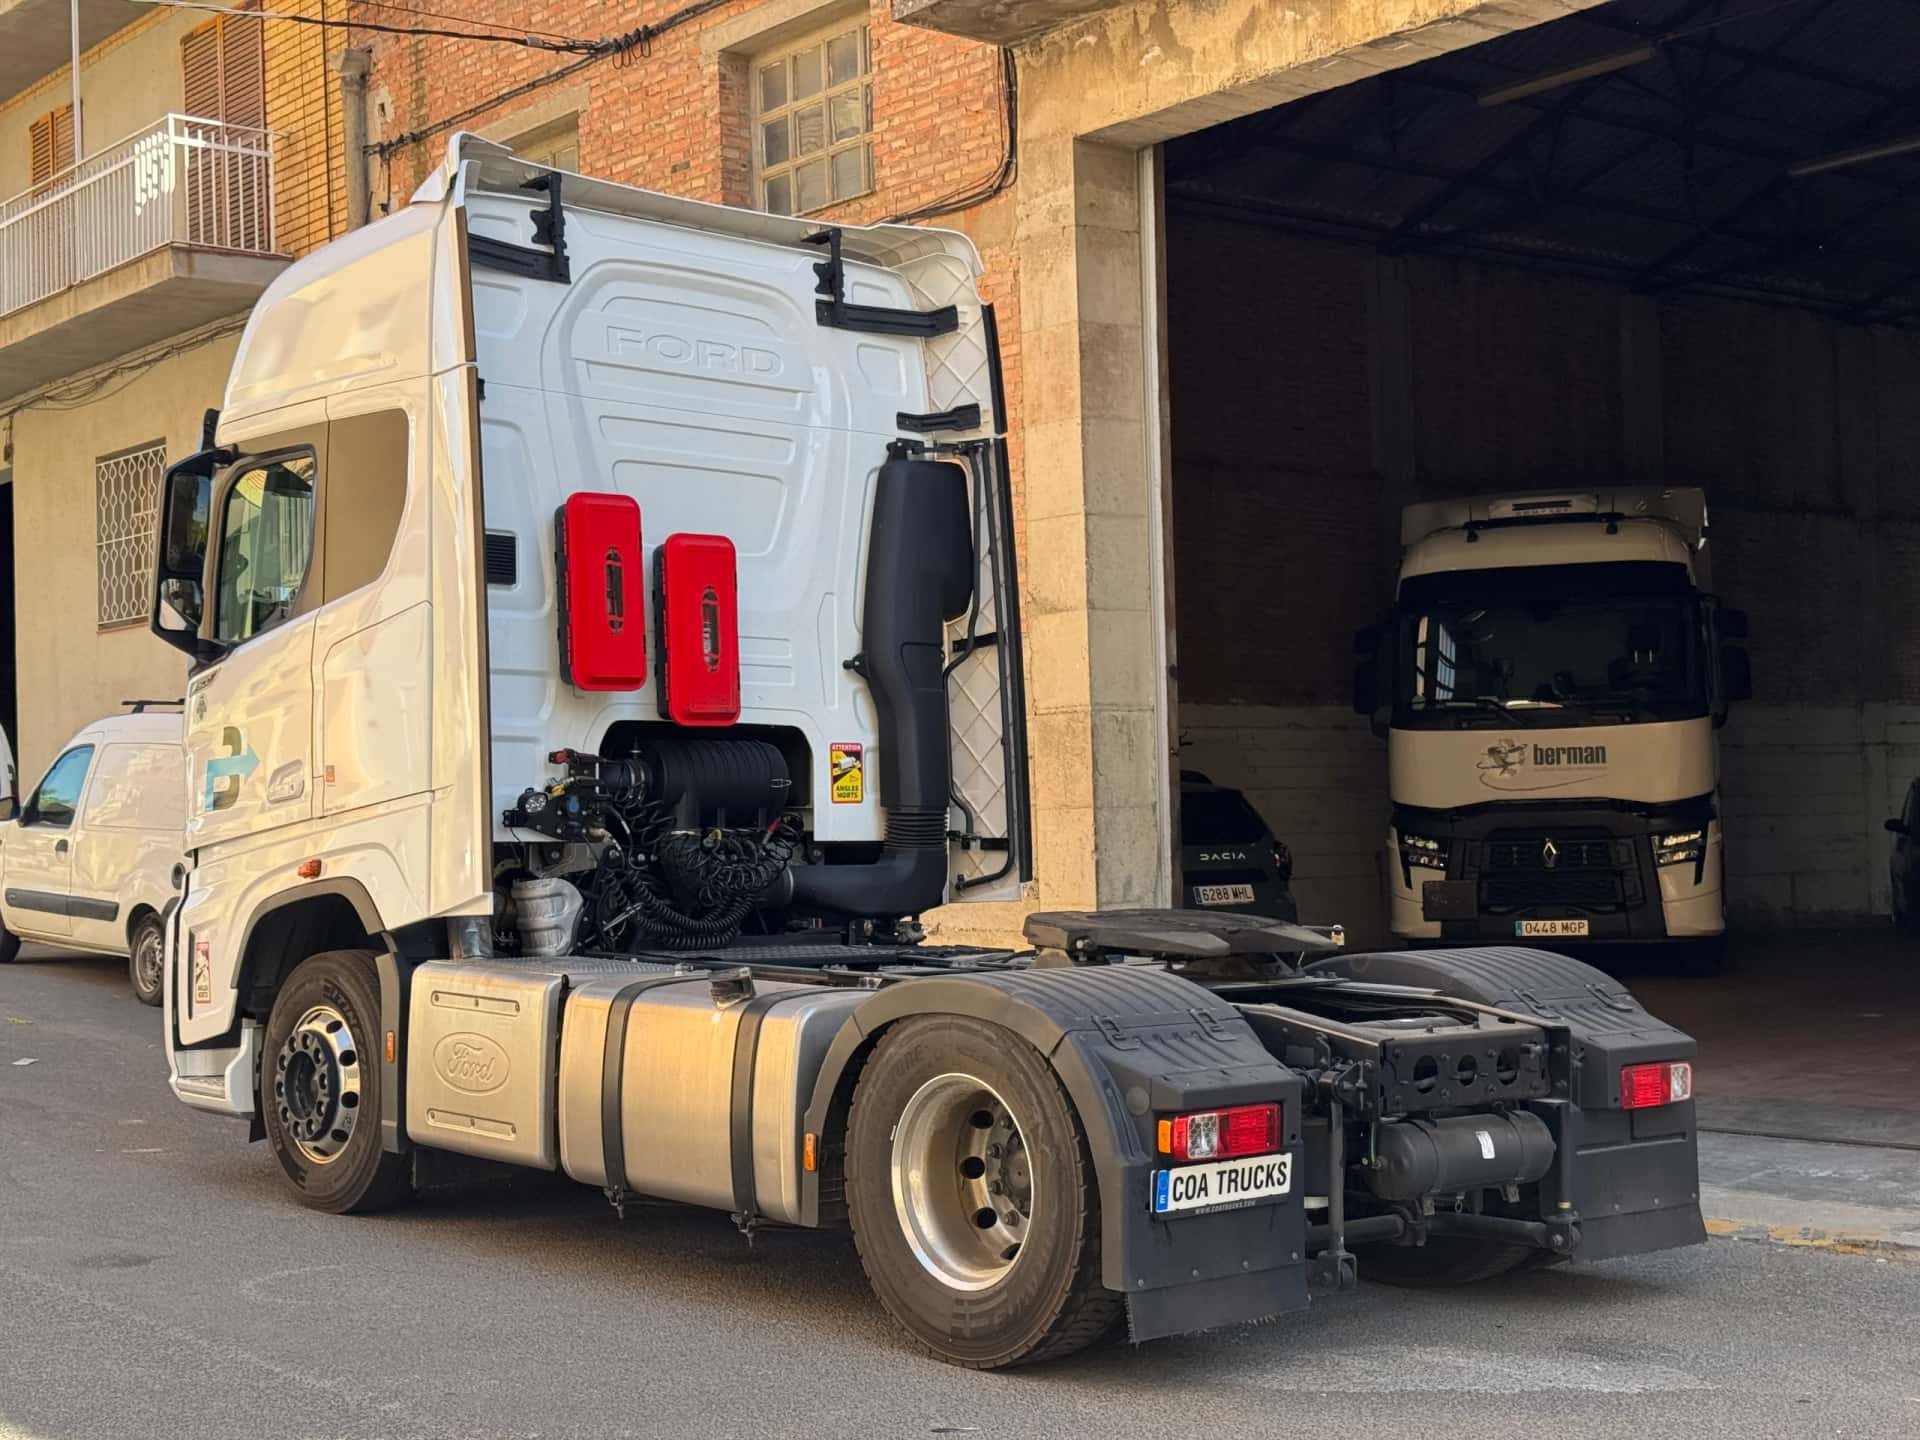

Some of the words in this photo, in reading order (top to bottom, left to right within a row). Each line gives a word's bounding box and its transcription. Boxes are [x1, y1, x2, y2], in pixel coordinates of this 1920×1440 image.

[606, 325, 784, 377] FORD
[1533, 743, 1607, 766] berman
[1199, 852, 1246, 860] DACIA
[1202, 887, 1230, 901] 6288
[1525, 922, 1557, 934] 0448
[1561, 922, 1585, 933] MGP
[447, 1041, 496, 1082] Ford
[1172, 1173, 1209, 1202] COA
[1216, 1161, 1288, 1195] TRUCKS
